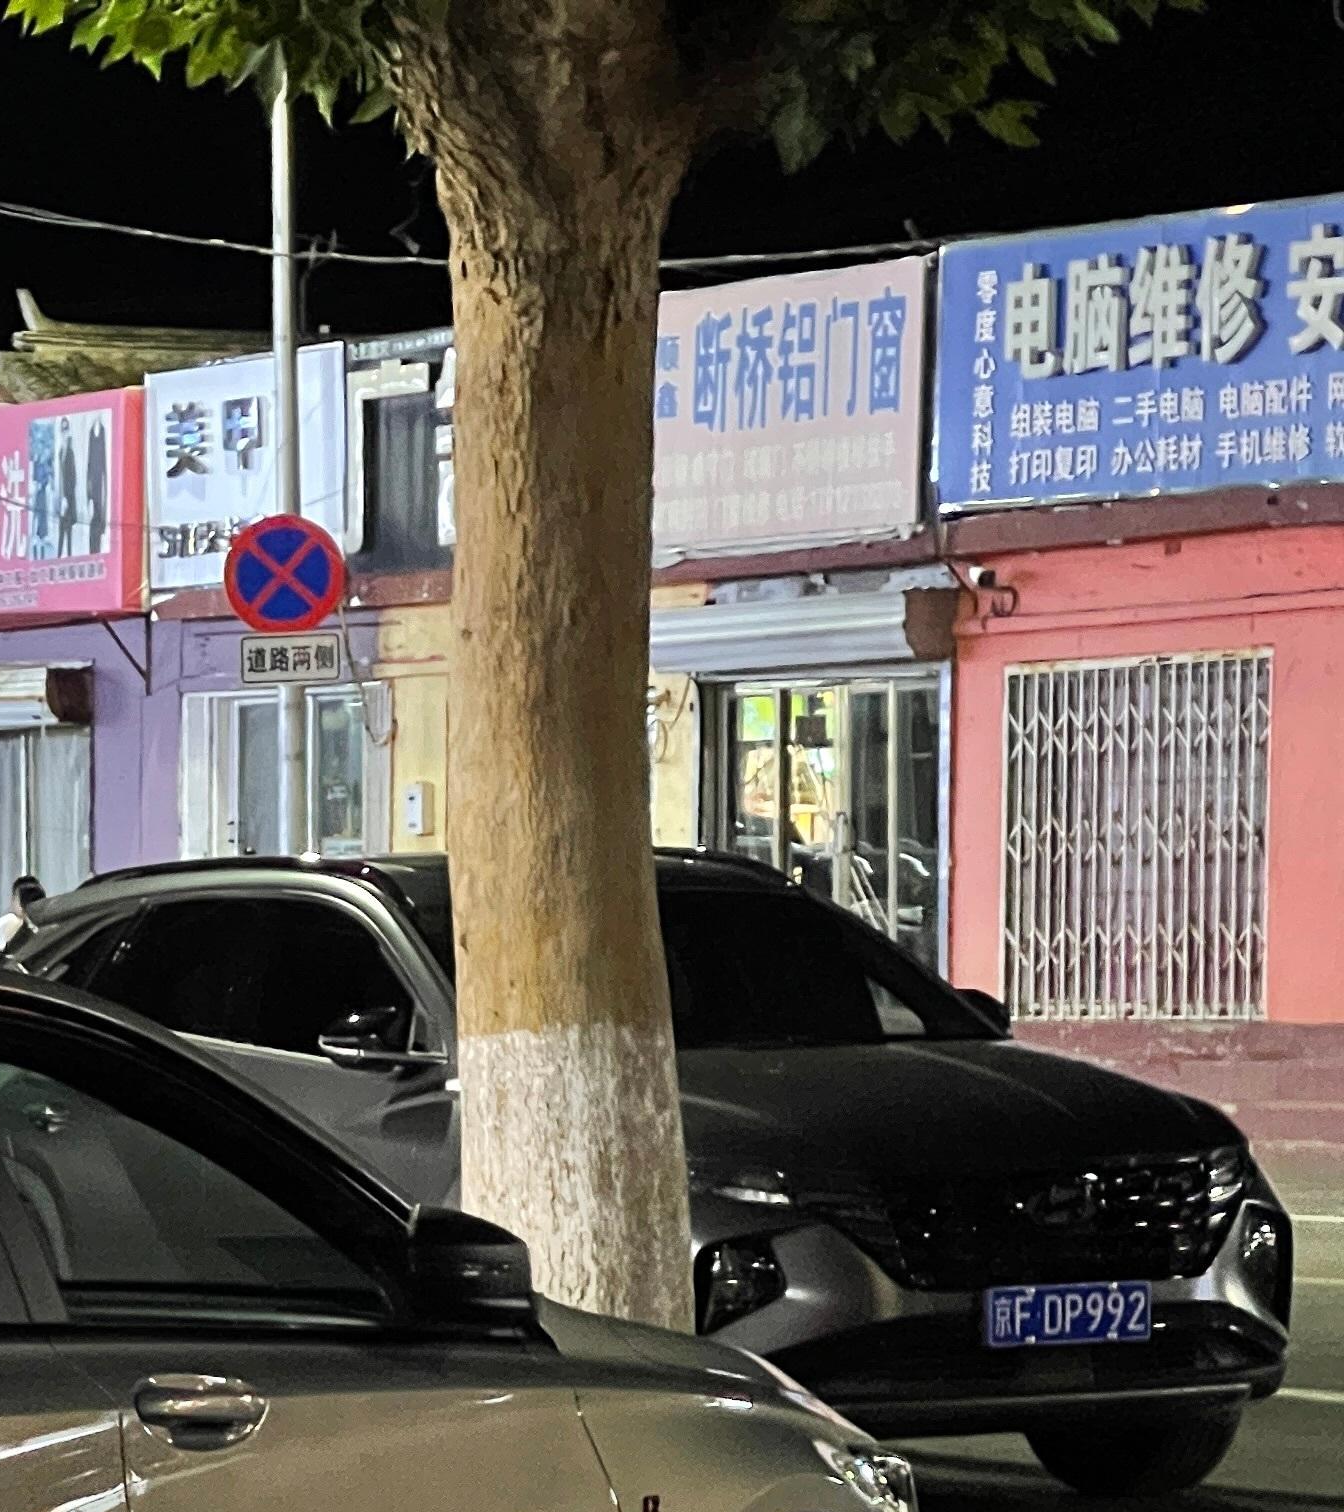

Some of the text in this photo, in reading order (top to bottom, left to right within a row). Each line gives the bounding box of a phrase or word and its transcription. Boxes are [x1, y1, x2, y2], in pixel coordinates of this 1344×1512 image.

[1005, 224, 1344, 379] 电脑维修 安
[693, 286, 906, 432] 断桥铝门窗
[969, 270, 998, 494] 零度心意科技
[165, 397, 261, 478] 美甲
[1010, 398, 1099, 438] 组装电脑
[1113, 387, 1204, 426] 二手电脑
[1219, 375, 1312, 419] 电脑配件
[1009, 445, 1097, 485] 打印复印
[1112, 433, 1202, 476] 办公耗材
[1216, 423, 1310, 468] 手机维修
[246, 645, 335, 674] 道路两侧
